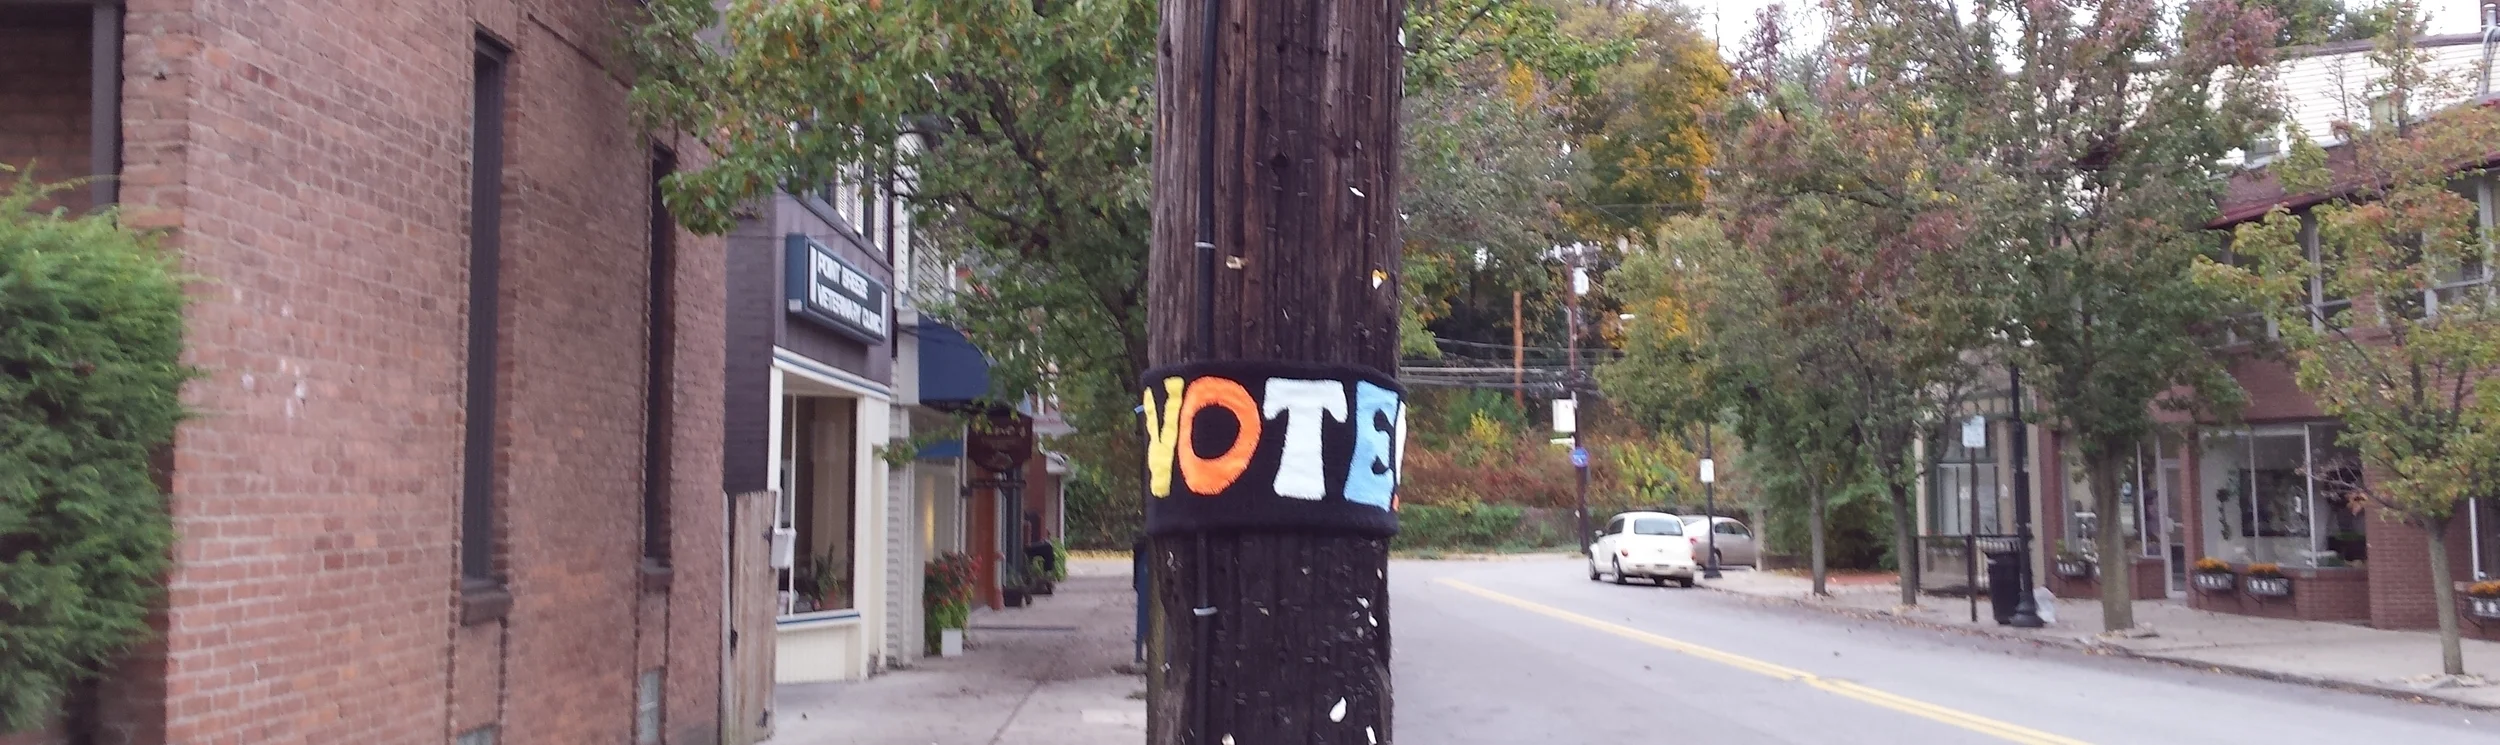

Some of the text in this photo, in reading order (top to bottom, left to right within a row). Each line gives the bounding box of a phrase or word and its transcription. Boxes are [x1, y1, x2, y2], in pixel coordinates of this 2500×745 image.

[817, 250, 868, 300] POINT BREEZE
[817, 282, 882, 334] VETERINARY CLINIC
